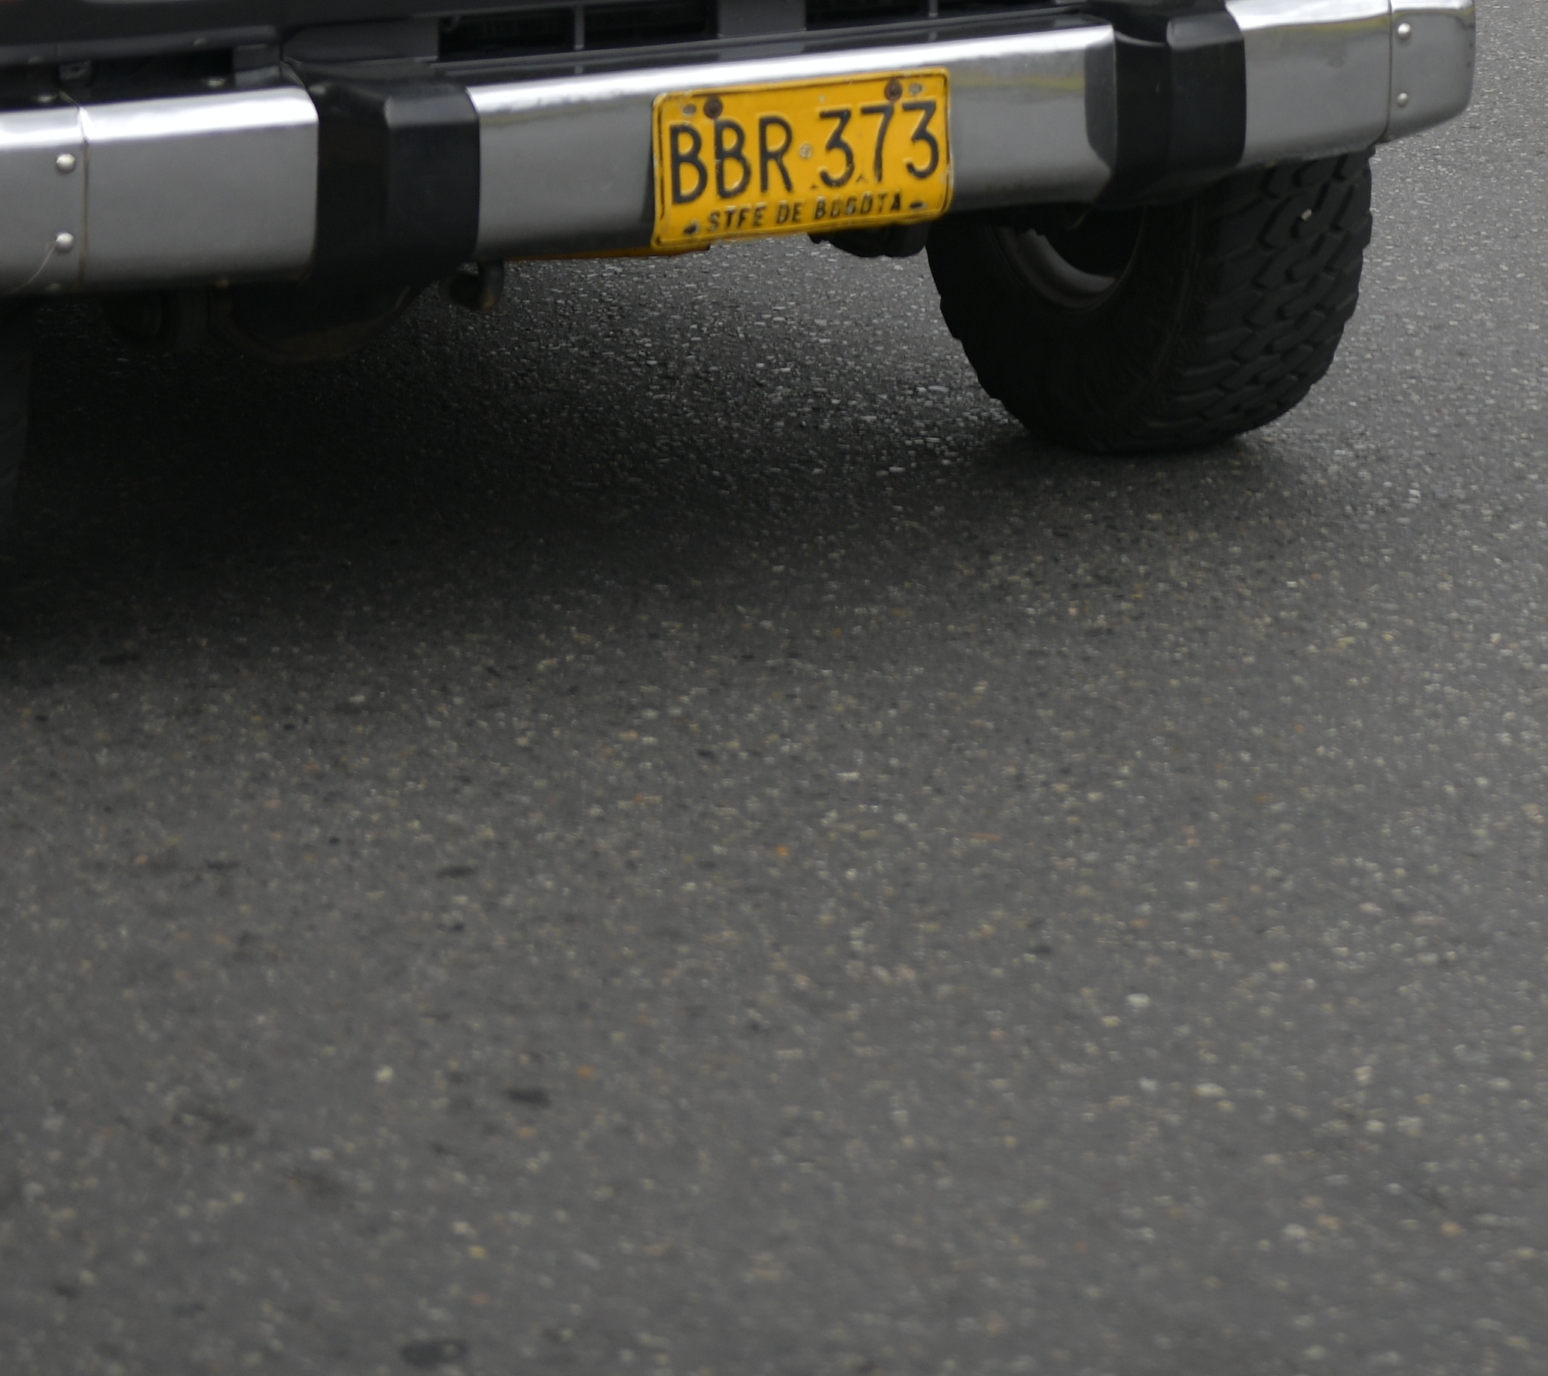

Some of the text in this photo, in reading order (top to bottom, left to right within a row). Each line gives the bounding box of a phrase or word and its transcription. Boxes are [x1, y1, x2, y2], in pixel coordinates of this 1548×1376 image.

[669, 100, 940, 205] BBR 373
[776, 200, 803, 225] DE
[814, 191, 902, 221] BOGOTA
